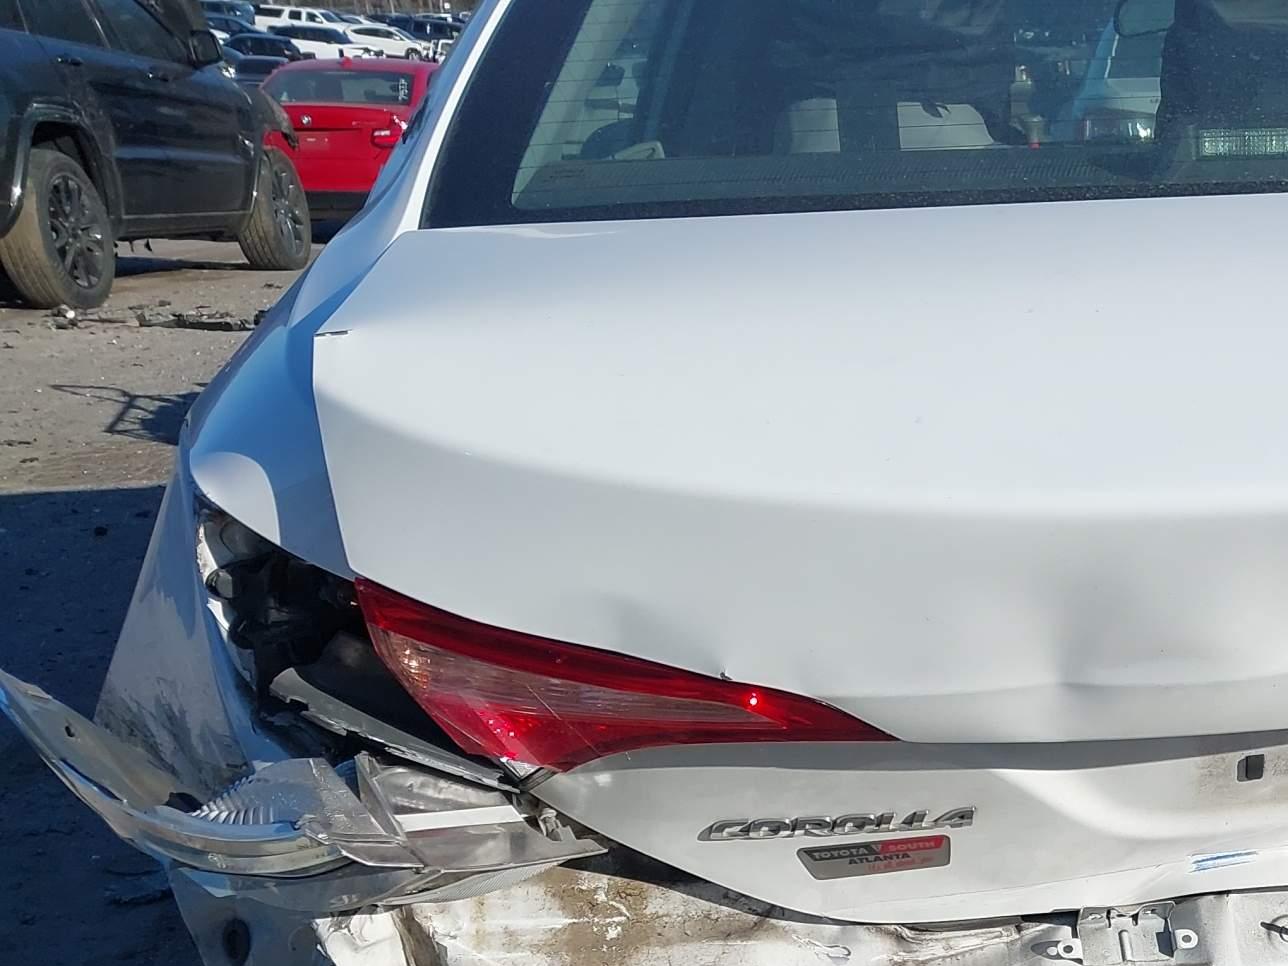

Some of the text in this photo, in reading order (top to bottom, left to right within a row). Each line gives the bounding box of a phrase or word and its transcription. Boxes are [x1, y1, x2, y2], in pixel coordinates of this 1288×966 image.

[697, 806, 977, 841] COROLLA
[813, 842, 936, 860] TOYOTA SOUTH
[848, 852, 912, 866] ATLANTA
